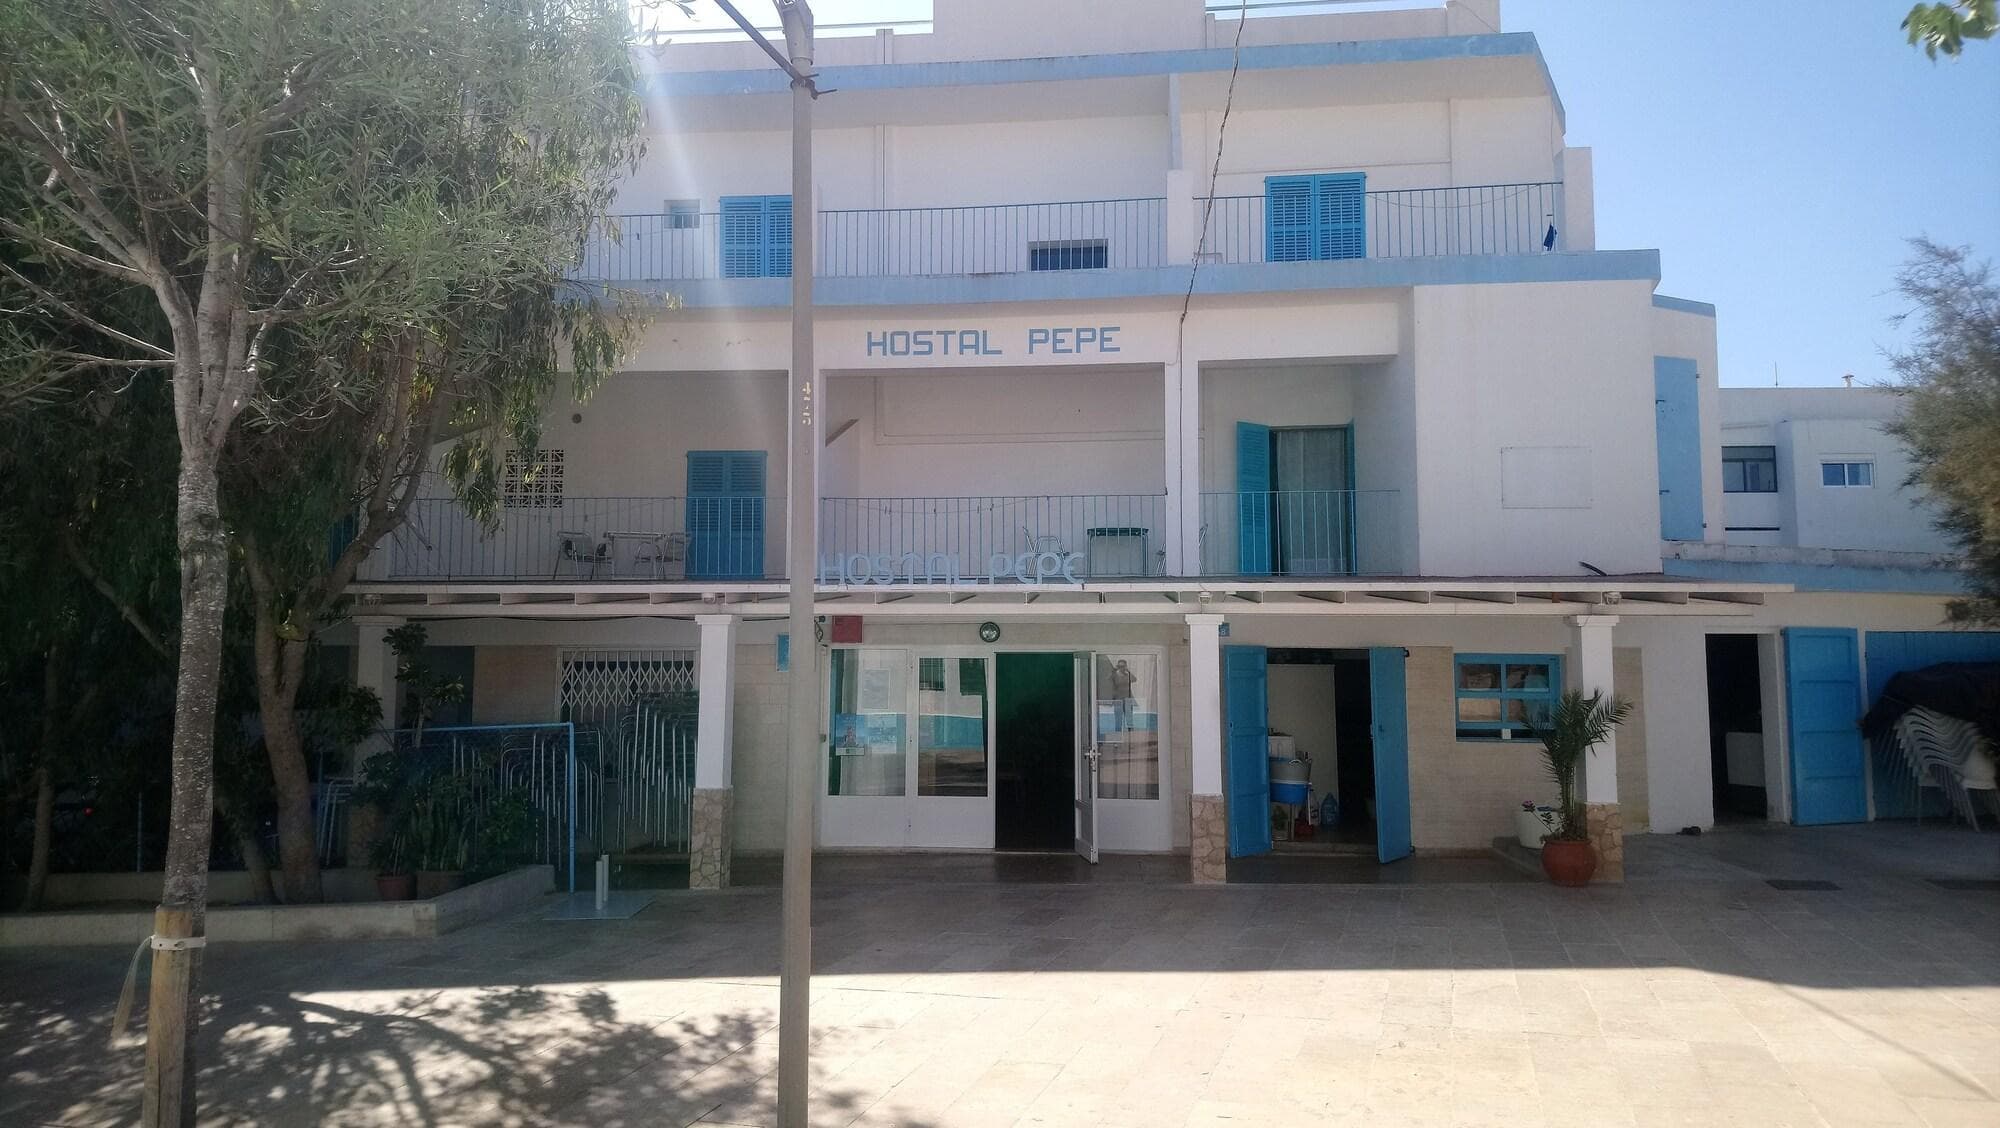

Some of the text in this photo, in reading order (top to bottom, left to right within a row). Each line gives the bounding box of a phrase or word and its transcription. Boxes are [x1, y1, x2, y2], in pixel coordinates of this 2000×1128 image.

[867, 326, 1121, 356] HOSTAL PEPE
[820, 551, 1086, 585] HOSTAL PEPE
